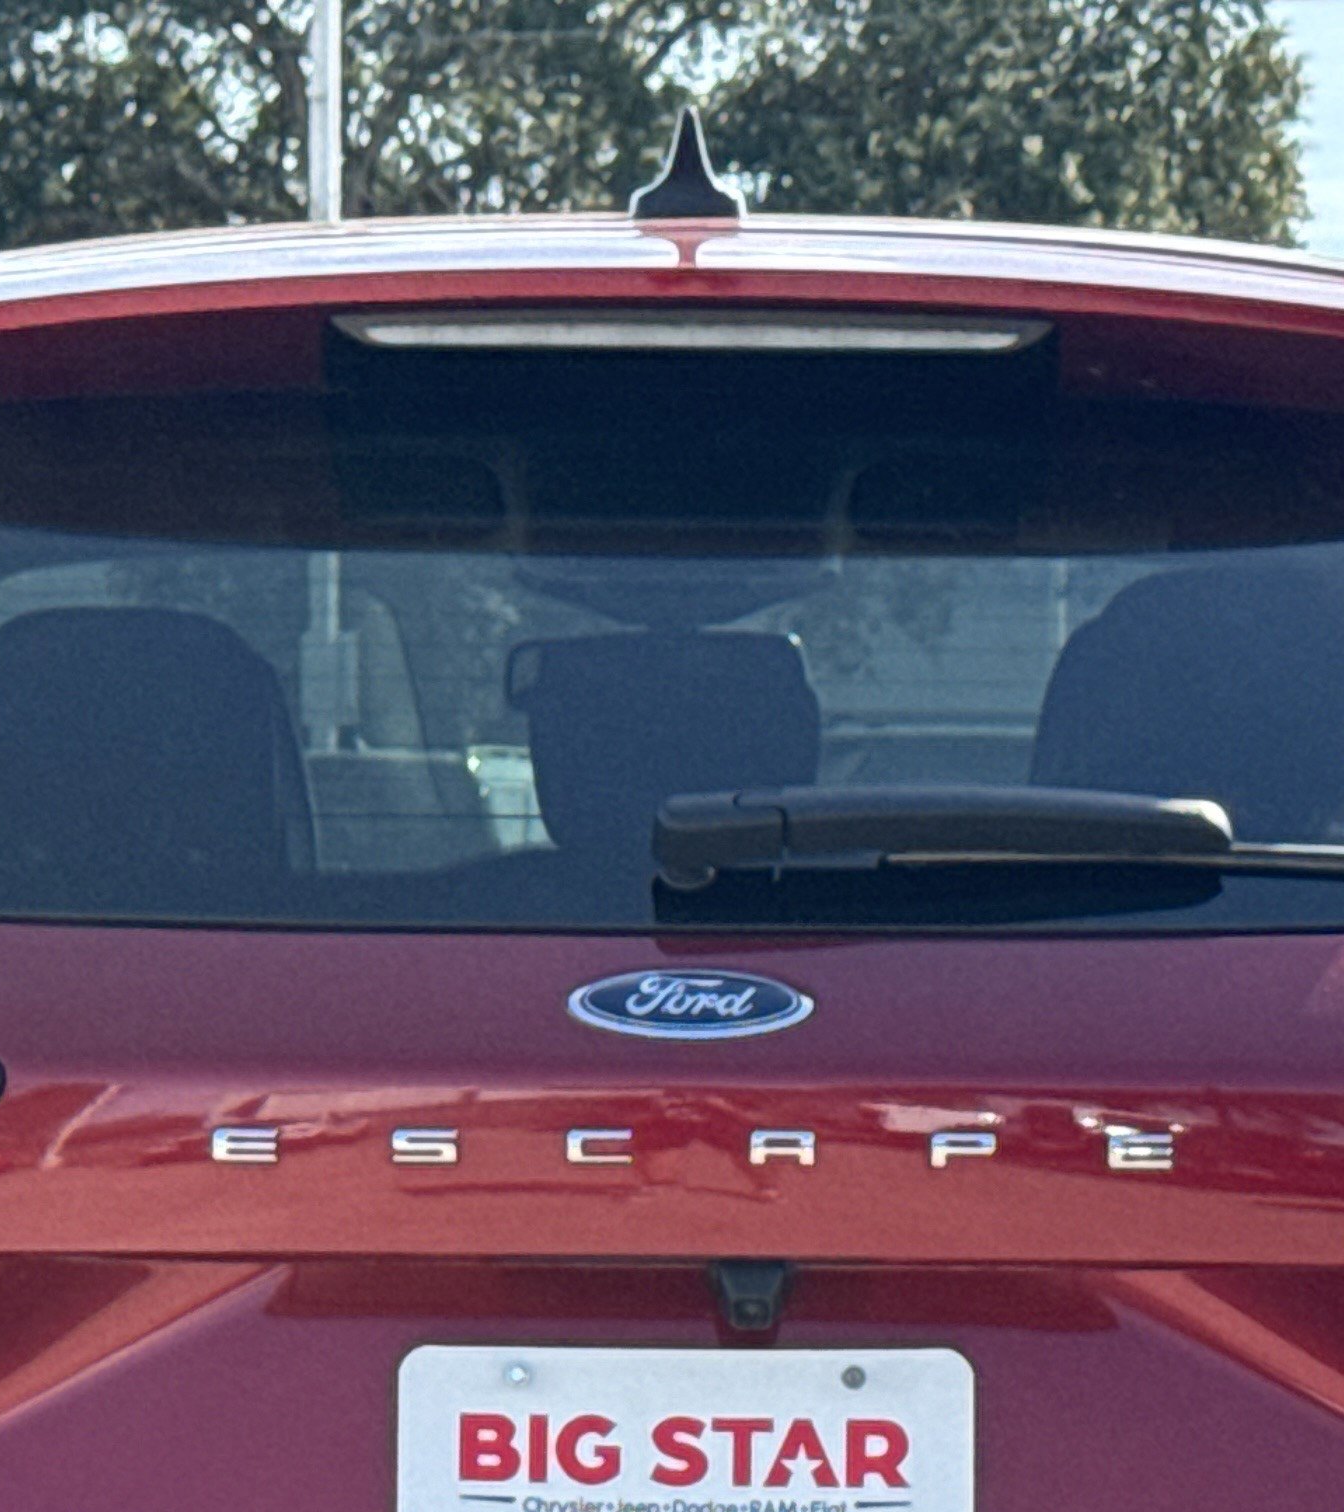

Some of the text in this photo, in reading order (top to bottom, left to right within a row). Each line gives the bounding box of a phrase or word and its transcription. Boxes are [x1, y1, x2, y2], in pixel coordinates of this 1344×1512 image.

[625, 975, 757, 1017] Ford
[211, 1127, 1174, 1170] ESCAPE
[458, 1412, 912, 1489] BIG STAR
